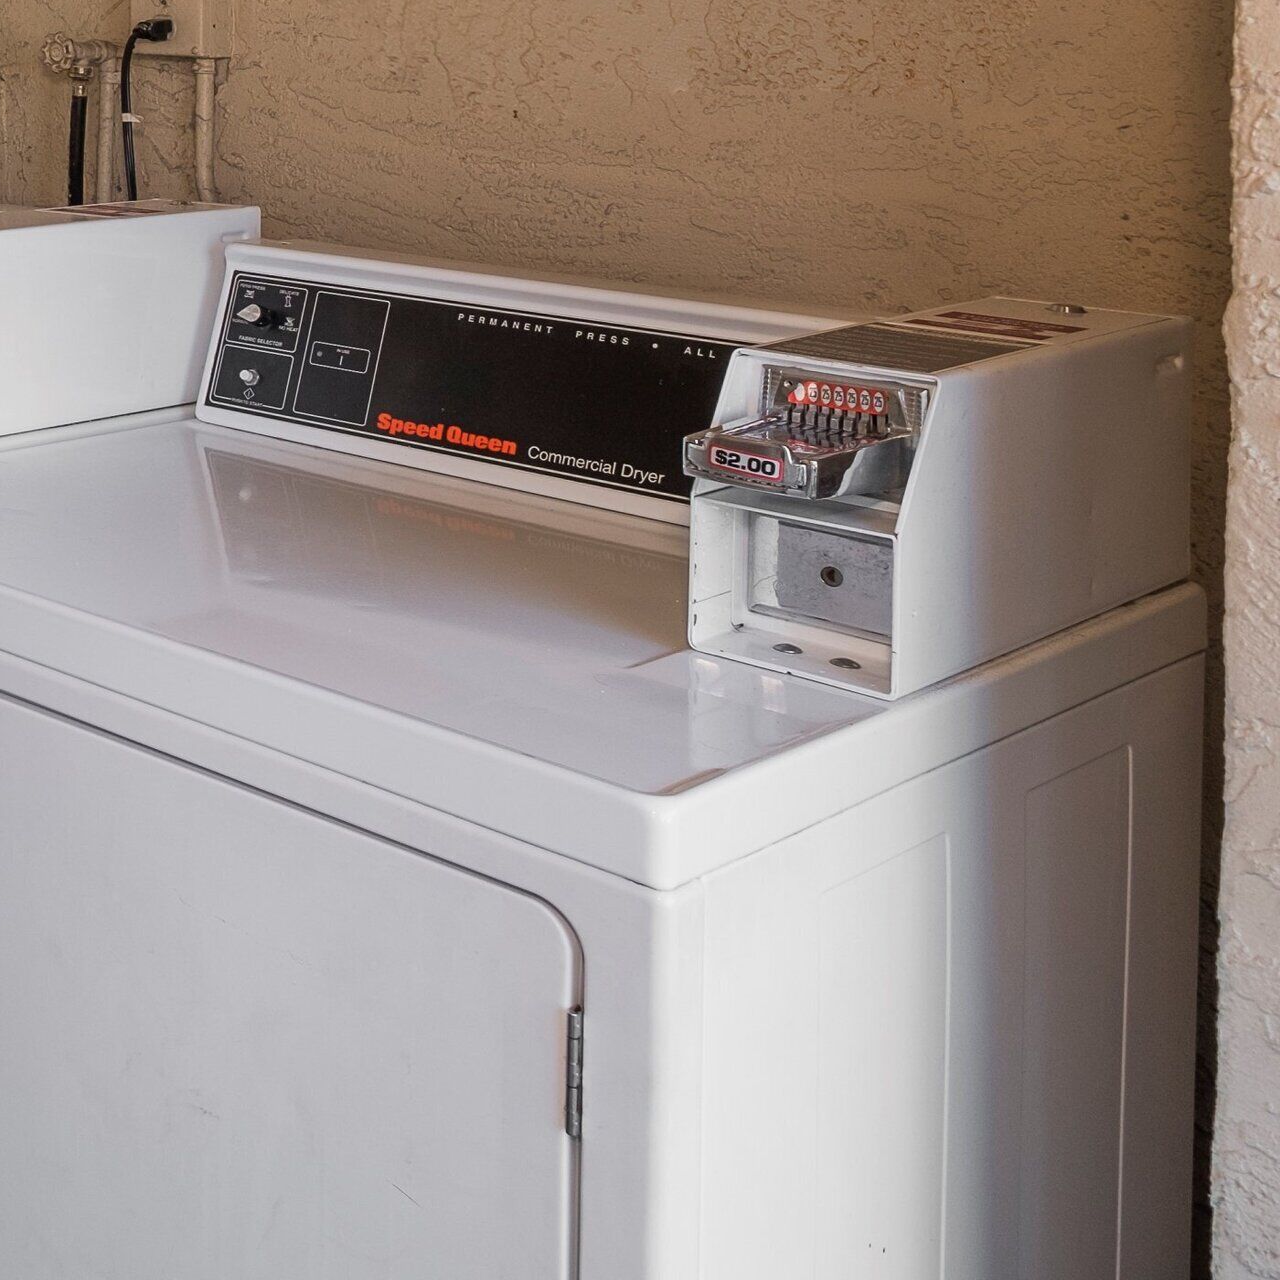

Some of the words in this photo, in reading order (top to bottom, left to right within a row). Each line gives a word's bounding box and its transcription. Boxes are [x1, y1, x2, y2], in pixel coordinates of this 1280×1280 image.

[238, 335, 256, 343] FABRIC
[257, 338, 283, 347] SELECTOR
[457, 313, 554, 334] PERMANENT
[575, 330, 630, 346] PRESS
[684, 346, 716, 359] ALL
[822, 388, 829, 399] 25
[835, 390, 842, 401] 25
[848, 392, 855, 403] 25
[861, 394, 869, 405] 25
[874, 396, 882, 407] 25
[376, 412, 443, 440] Speed
[446, 425, 517, 455] Queen
[527, 445, 616, 475] Commercial
[620, 464, 665, 485] Dryer
[715, 449, 776, 476] $2.00
